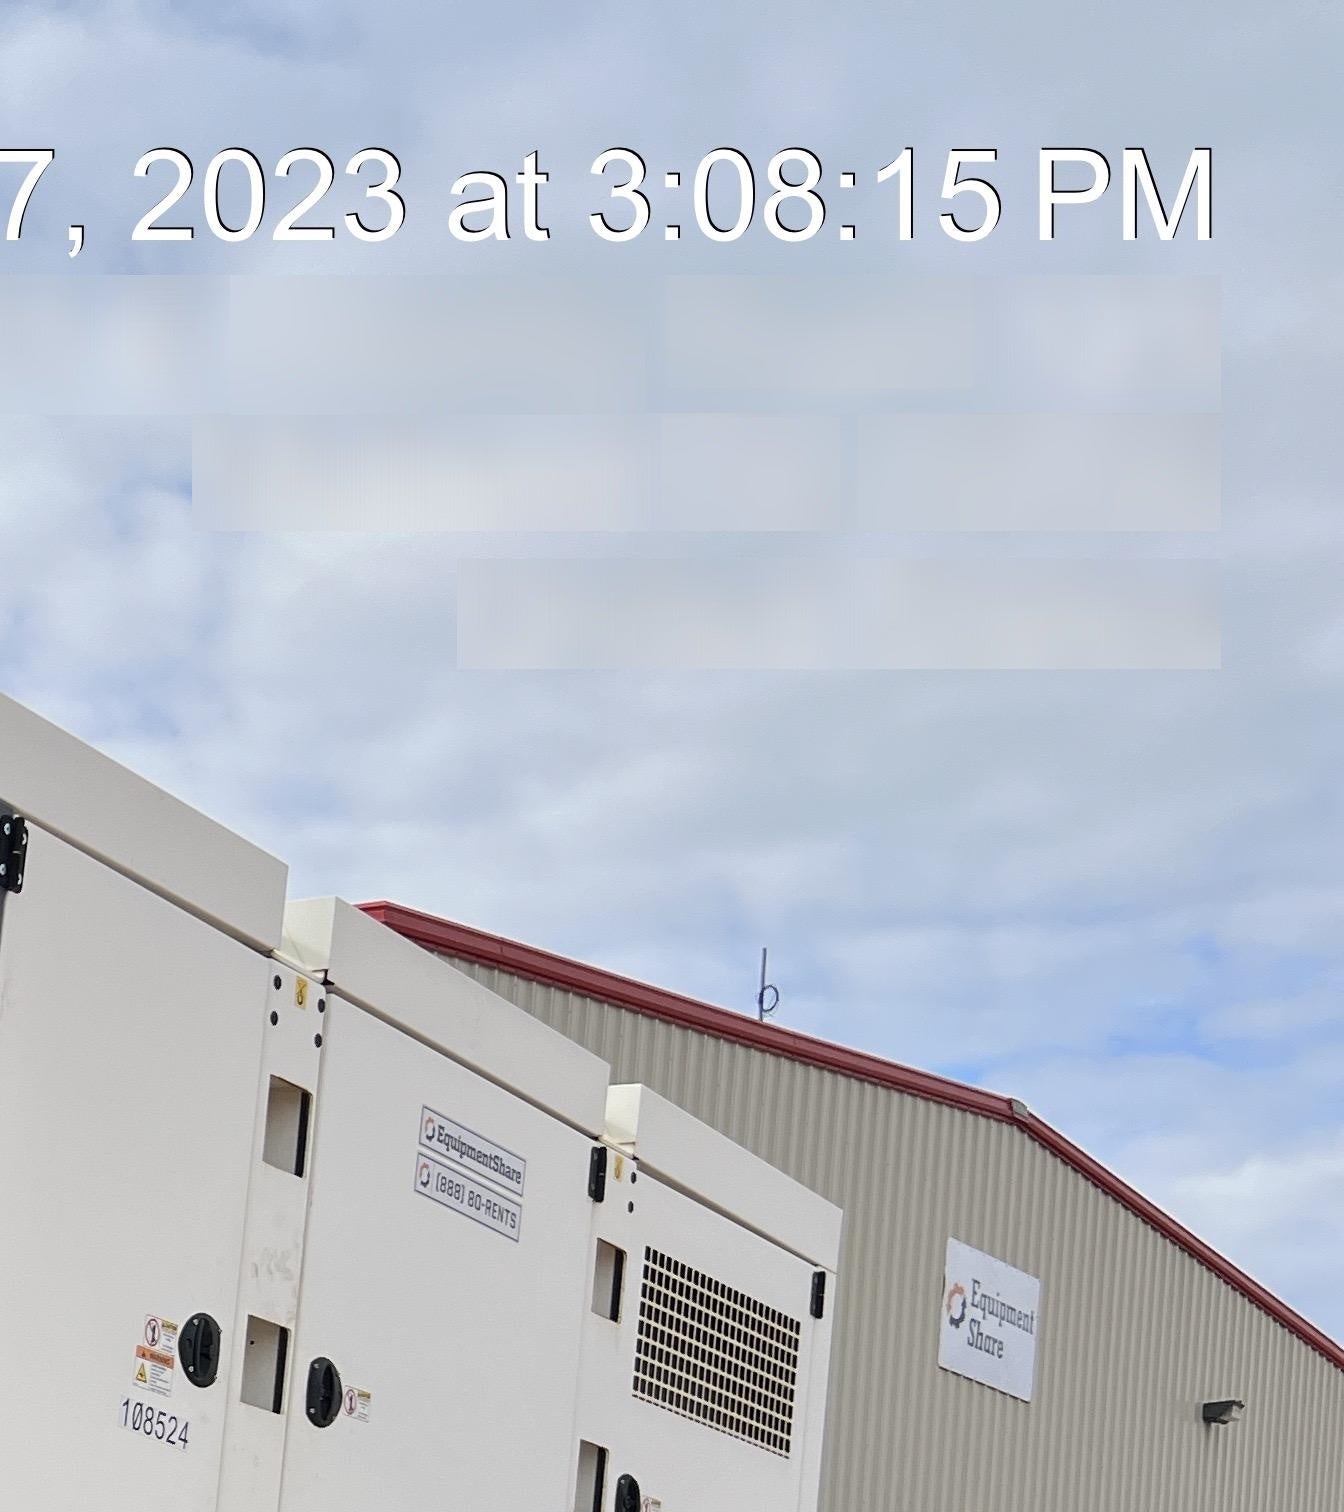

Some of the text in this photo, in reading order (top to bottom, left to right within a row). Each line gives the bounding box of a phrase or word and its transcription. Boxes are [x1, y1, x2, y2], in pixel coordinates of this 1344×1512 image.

[435, 1172, 517, 1229] (888) 80-RENTS
[970, 1277, 1035, 1335] Equipment
[967, 1318, 1004, 1359] Share
[121, 1396, 189, 1451] 108524
